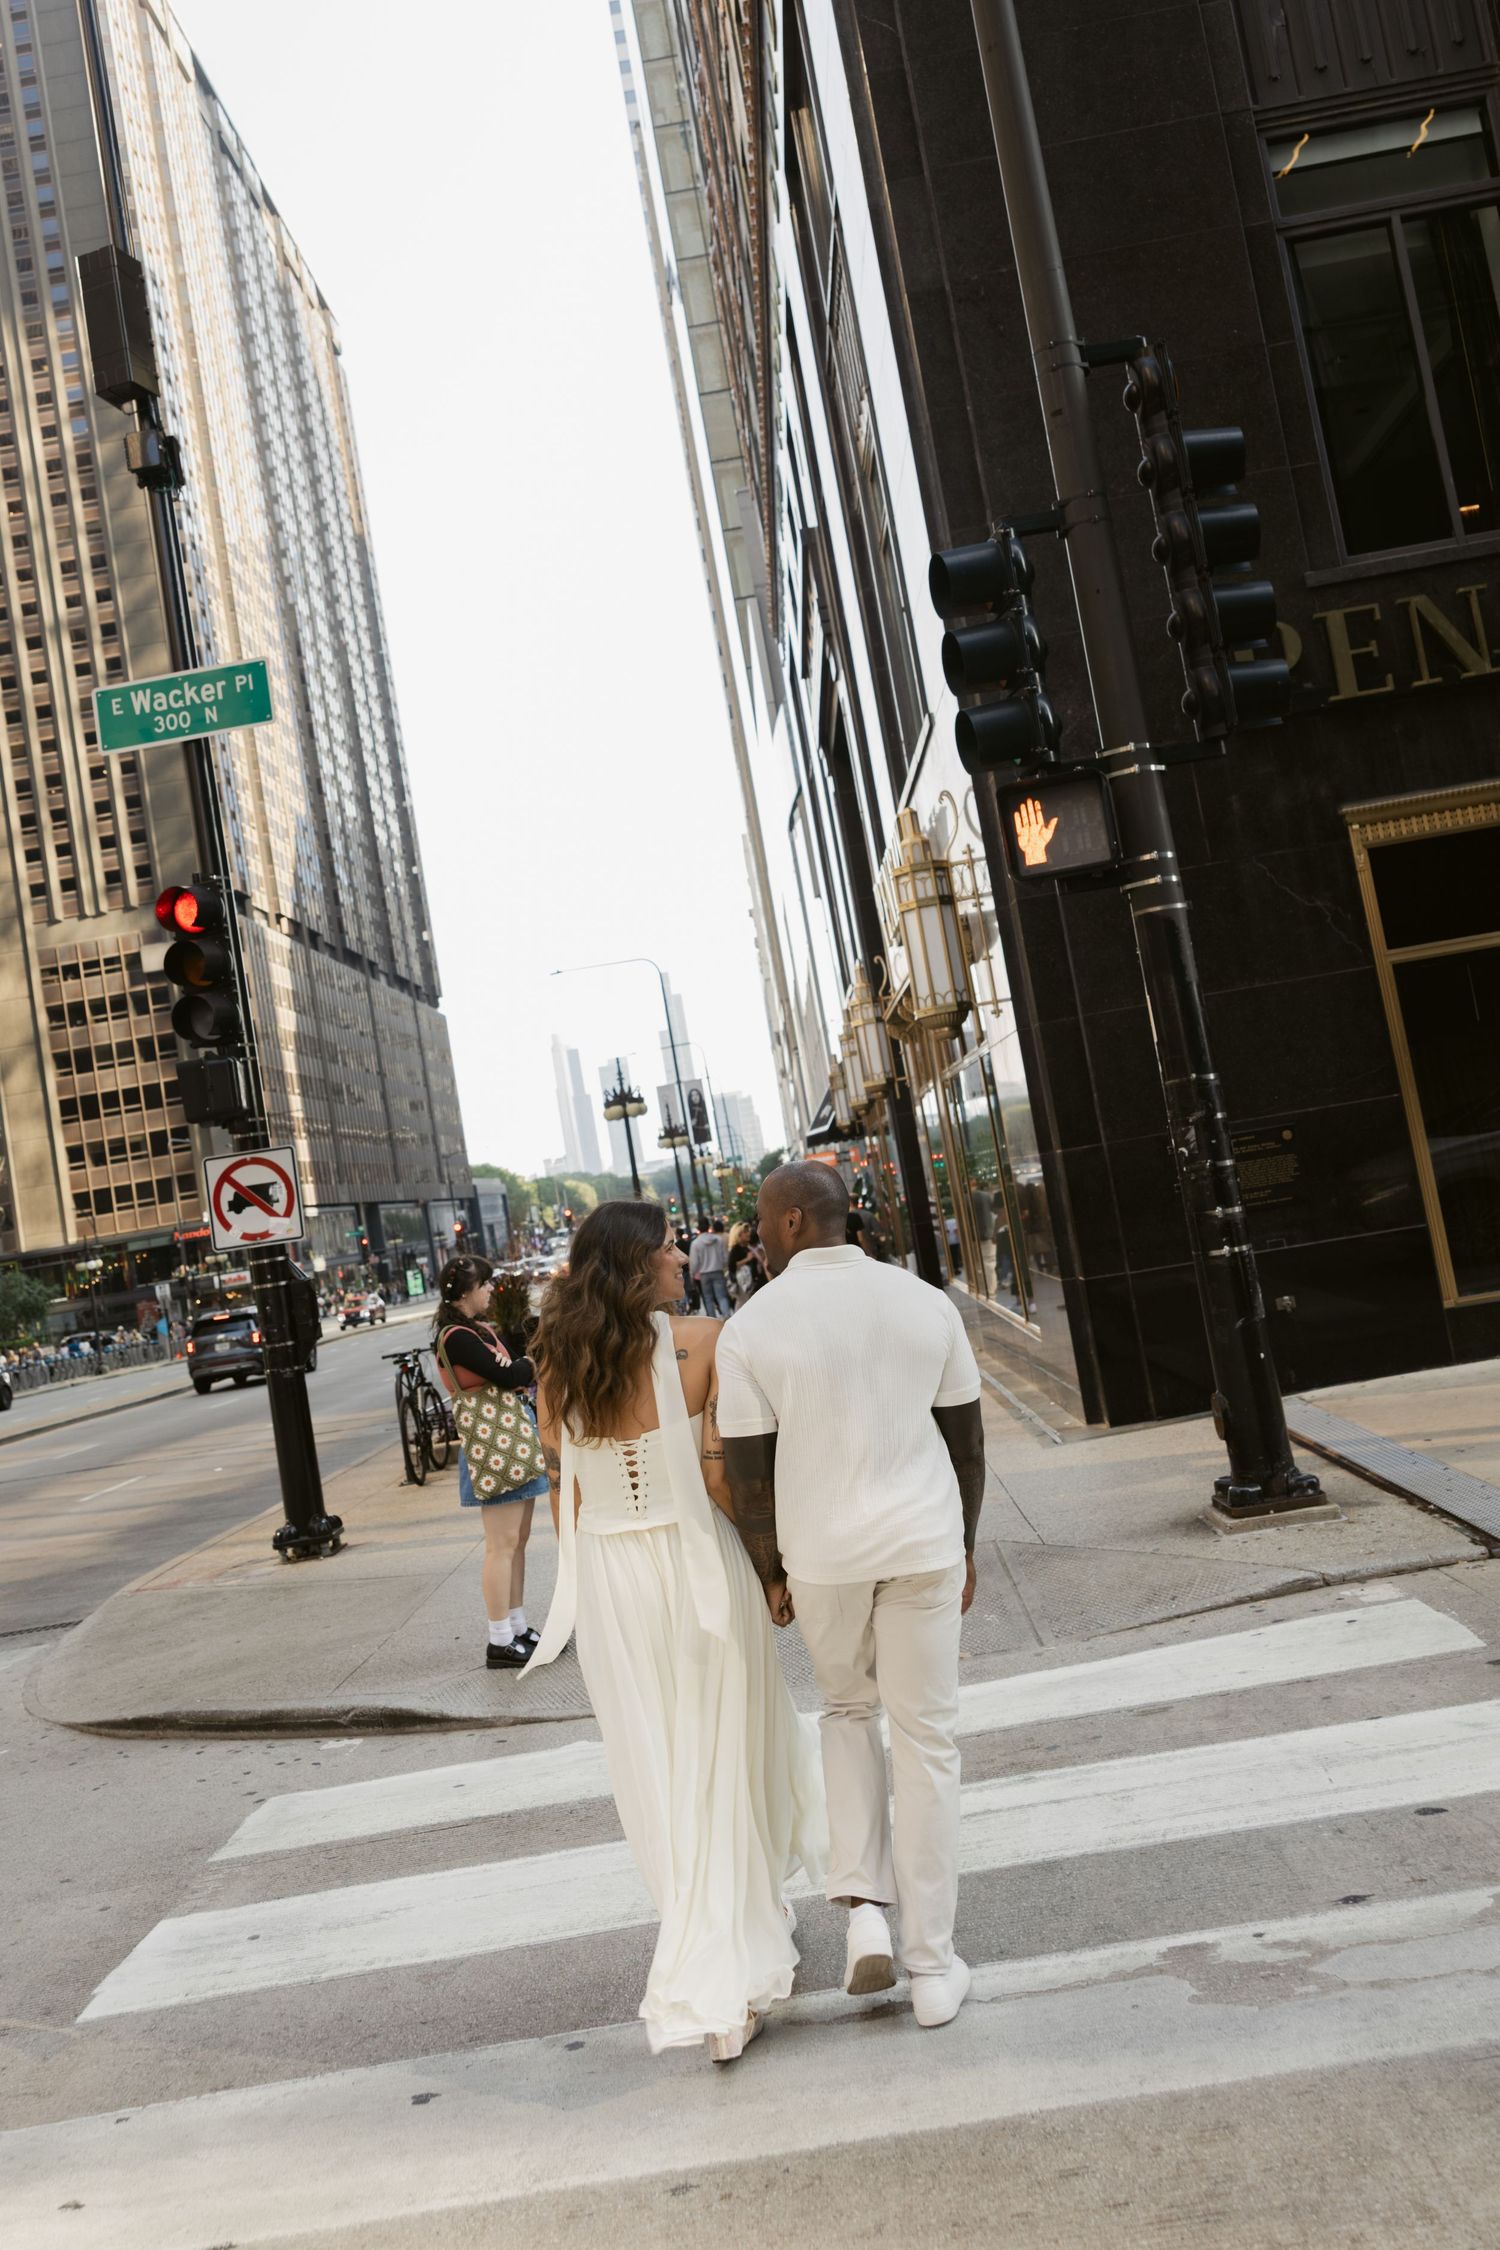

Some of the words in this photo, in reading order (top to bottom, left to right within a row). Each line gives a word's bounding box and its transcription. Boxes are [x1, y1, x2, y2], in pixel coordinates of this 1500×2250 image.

[111, 698, 124, 716] E
[130, 680, 227, 716] Wacker
[234, 673, 255, 693] Pl
[153, 710, 191, 734] 300
[204, 705, 219, 725] N
